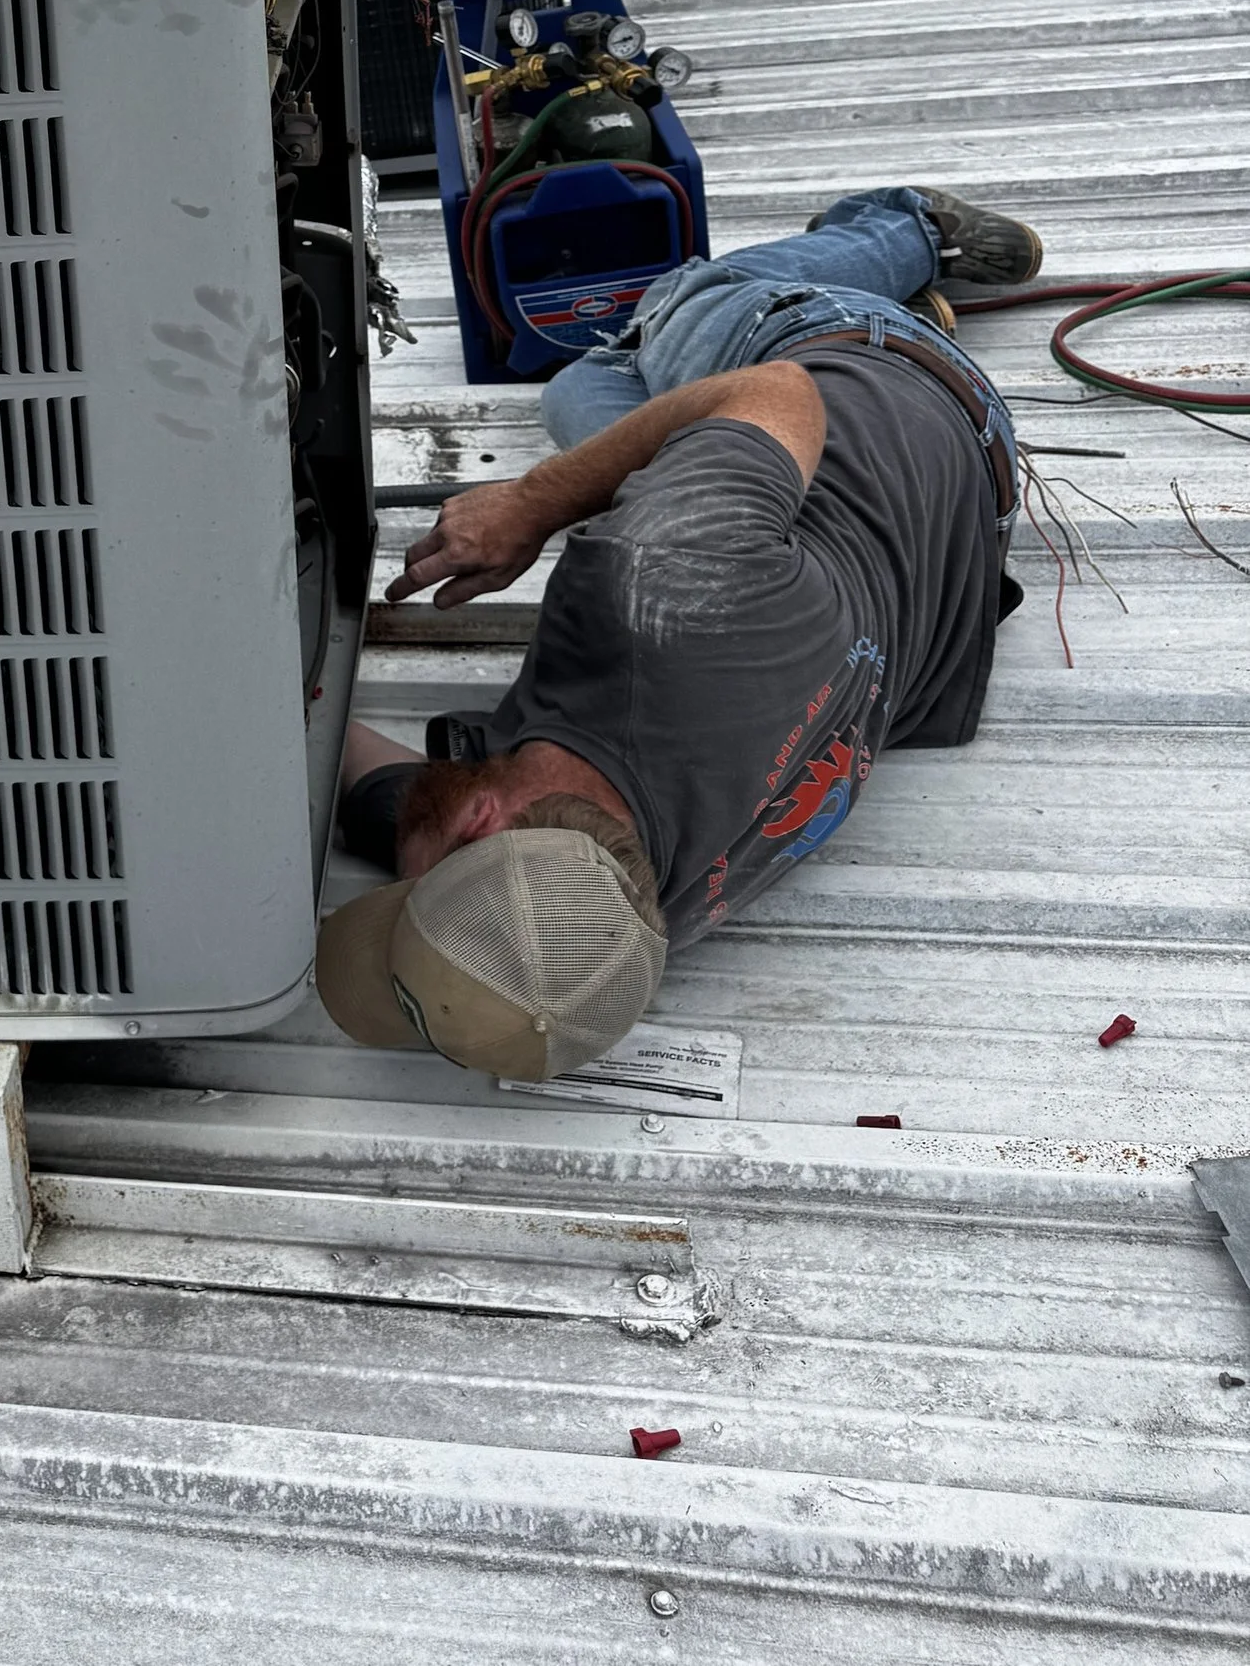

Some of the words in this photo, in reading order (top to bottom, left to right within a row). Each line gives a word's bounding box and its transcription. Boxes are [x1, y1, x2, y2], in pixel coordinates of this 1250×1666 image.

[766, 725, 803, 791] AND
[807, 685, 832, 725] AIR
[637, 1050, 684, 1061] SERVICE
[685, 1056, 721, 1068] FACTS
